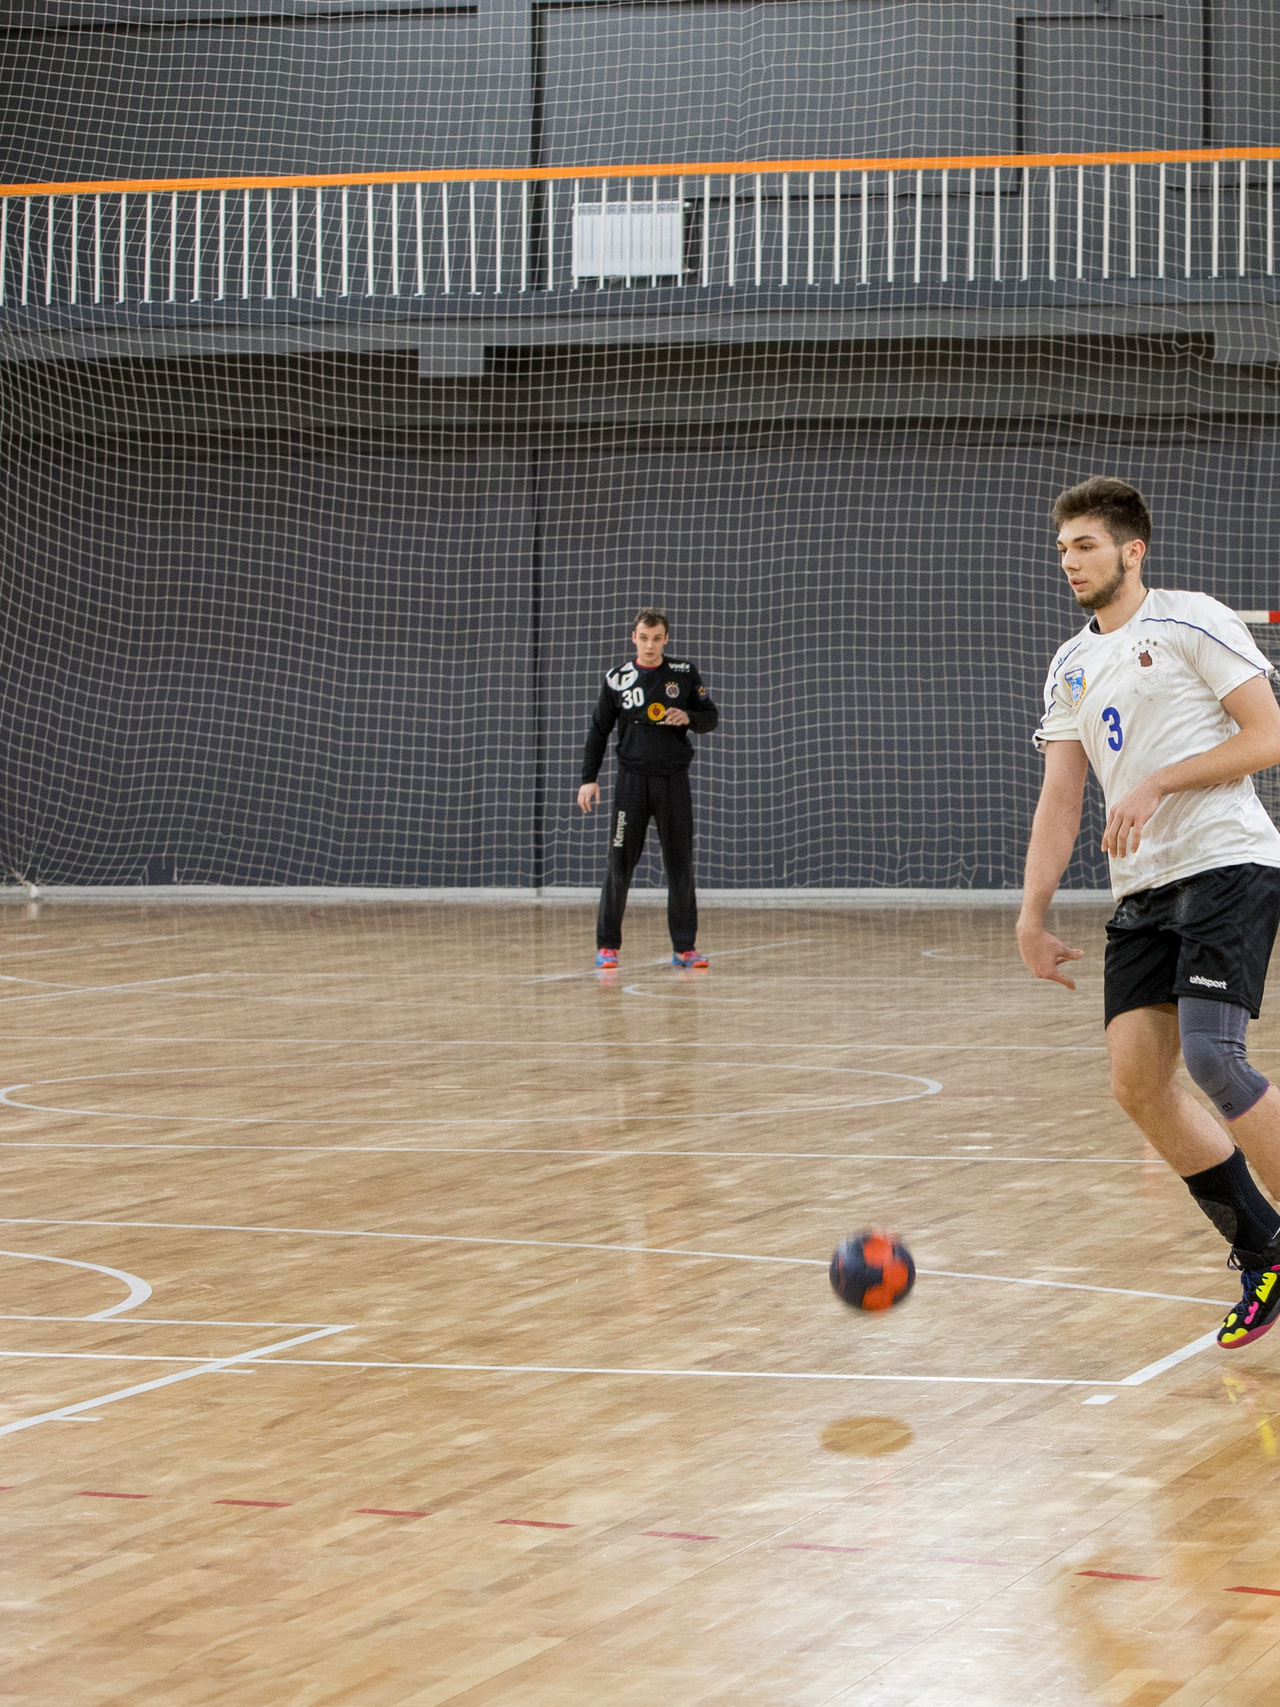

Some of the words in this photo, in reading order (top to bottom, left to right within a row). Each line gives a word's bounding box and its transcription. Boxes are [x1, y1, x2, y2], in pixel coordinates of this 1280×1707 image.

[622, 687, 645, 710] 30
[1102, 707, 1123, 752] 3
[613, 810, 628, 847] Kempa
[1189, 975, 1227, 990] uhlsport
